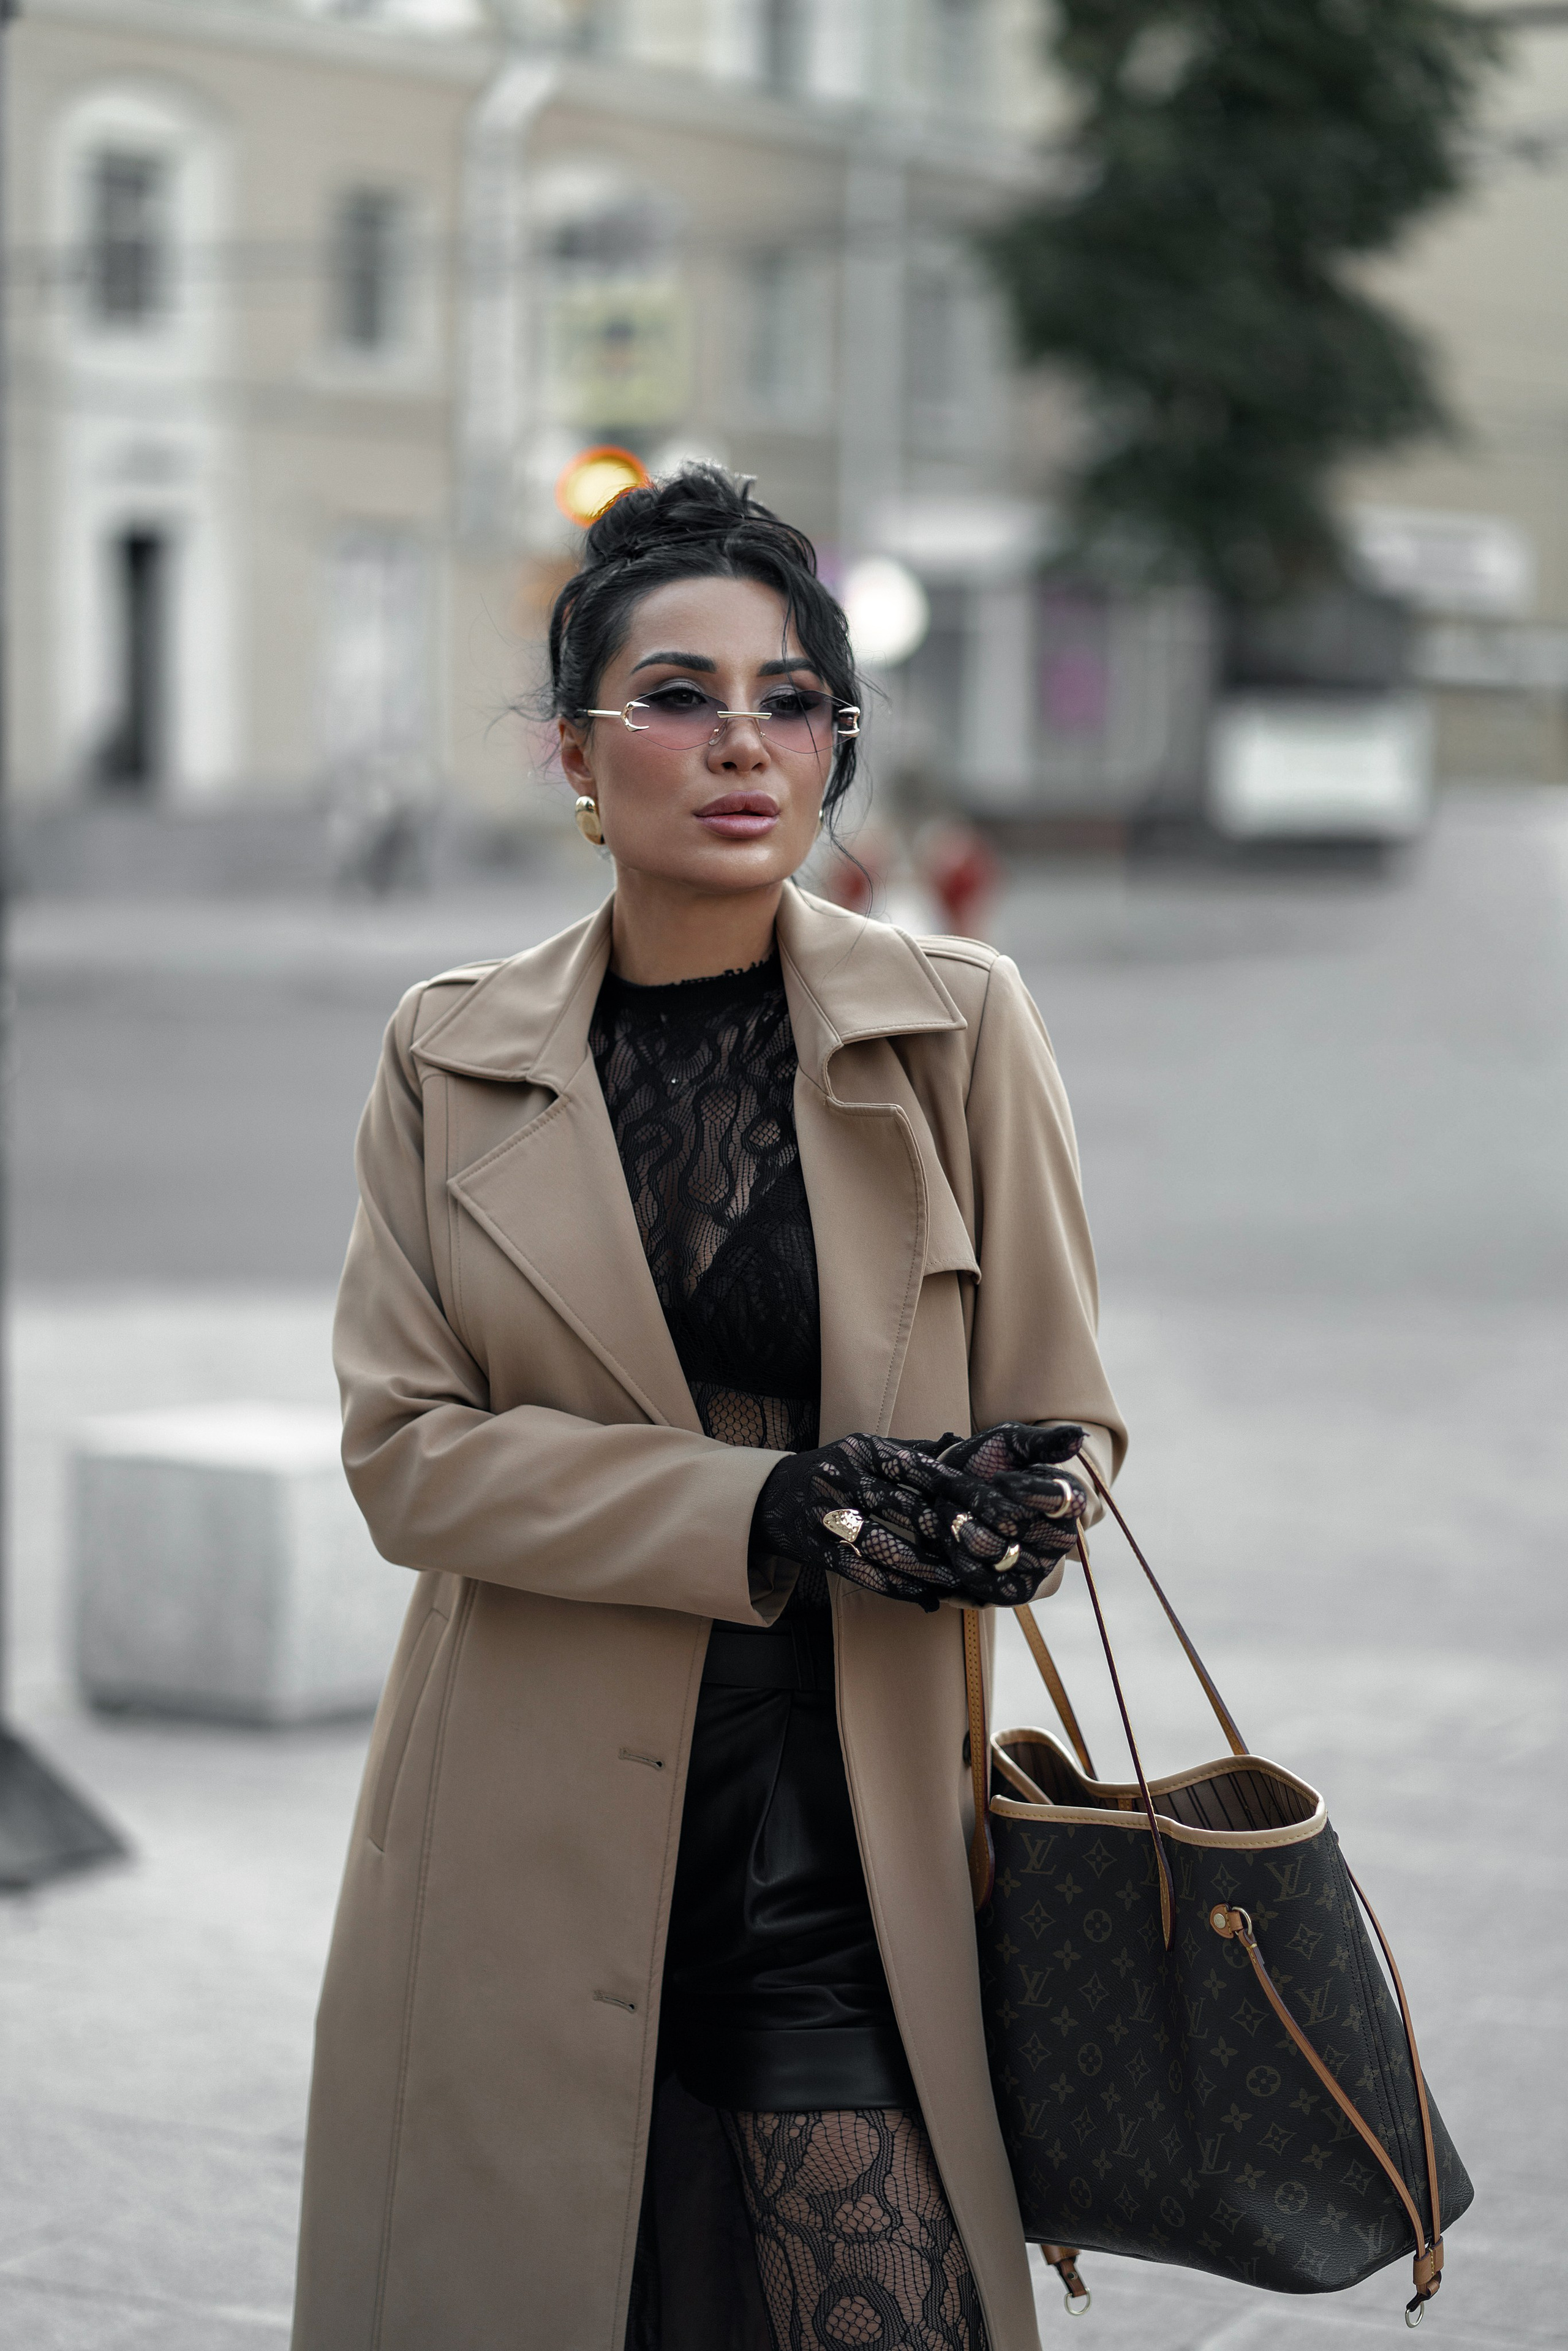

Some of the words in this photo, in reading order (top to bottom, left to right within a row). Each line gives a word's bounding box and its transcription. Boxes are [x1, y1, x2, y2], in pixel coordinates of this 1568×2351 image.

[1019, 1832, 1058, 1875] LV
[1264, 1854, 1311, 1902] LV
[1017, 1963, 1054, 2008] LV
[1295, 1976, 1338, 2028] LV
[1112, 2112, 1145, 2159] LV
[1195, 2132, 1231, 2175] LV
